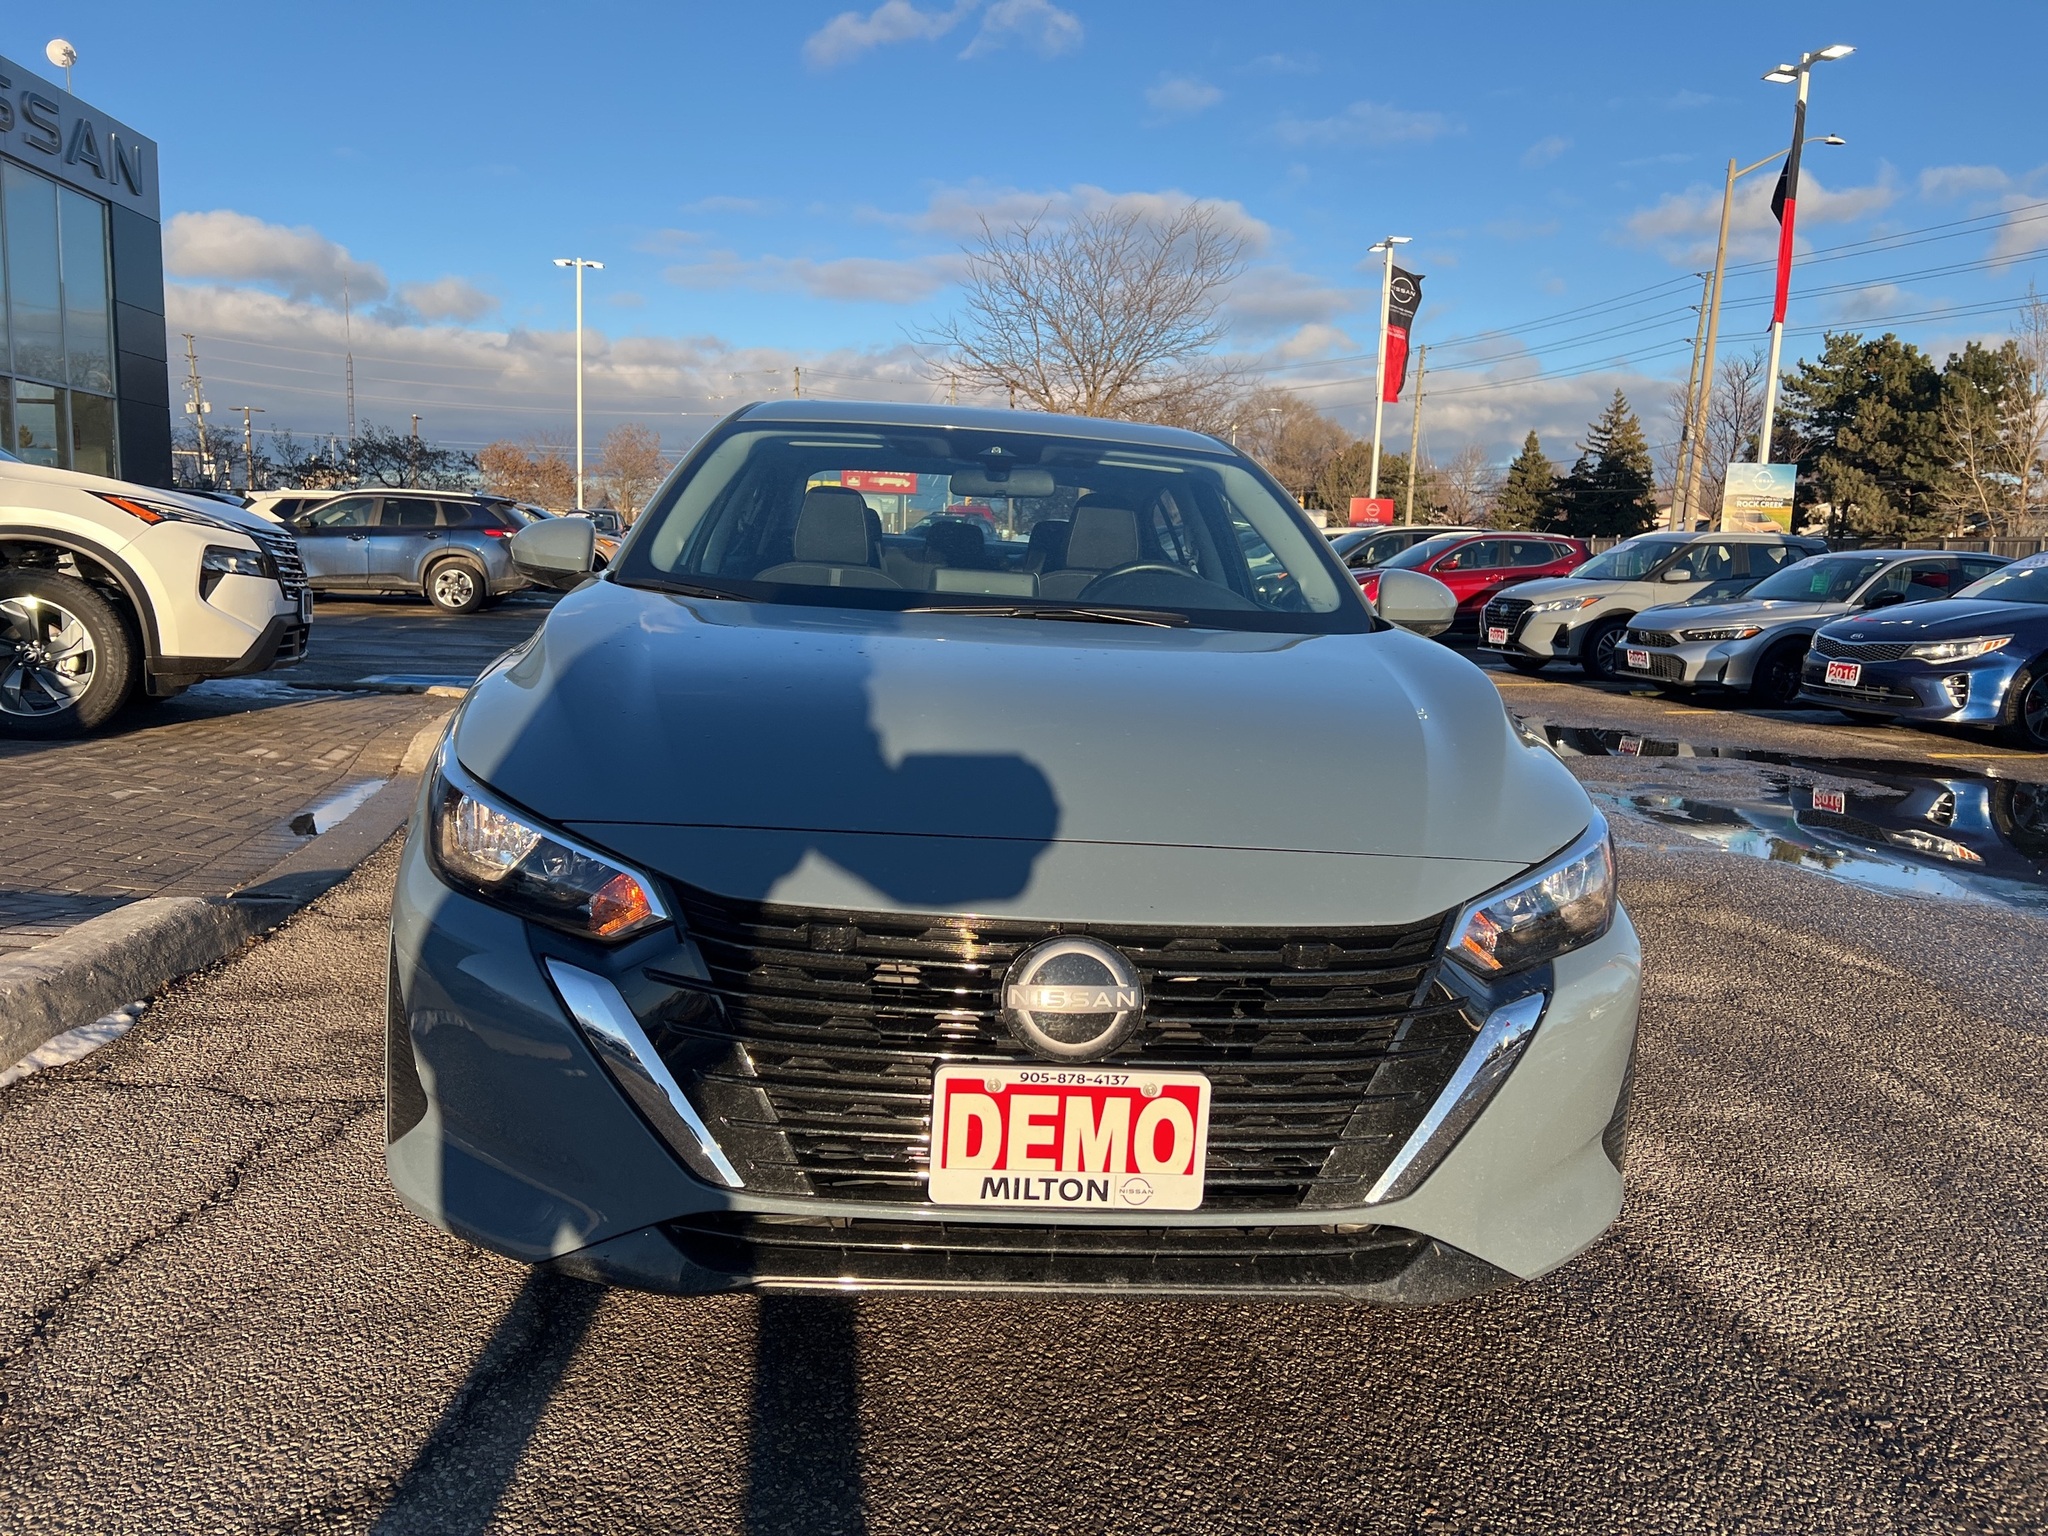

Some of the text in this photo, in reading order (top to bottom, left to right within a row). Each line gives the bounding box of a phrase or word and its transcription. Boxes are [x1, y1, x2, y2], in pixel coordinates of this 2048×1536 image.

[1736, 500, 1784, 509] ROCK CREEK
[1829, 666, 1856, 680] 2016
[1011, 988, 1135, 1009] NISSAN
[1020, 1072, 1129, 1086] 905-878-4137
[946, 1092, 1195, 1175] DEMO
[980, 1176, 1109, 1202] MILTON
